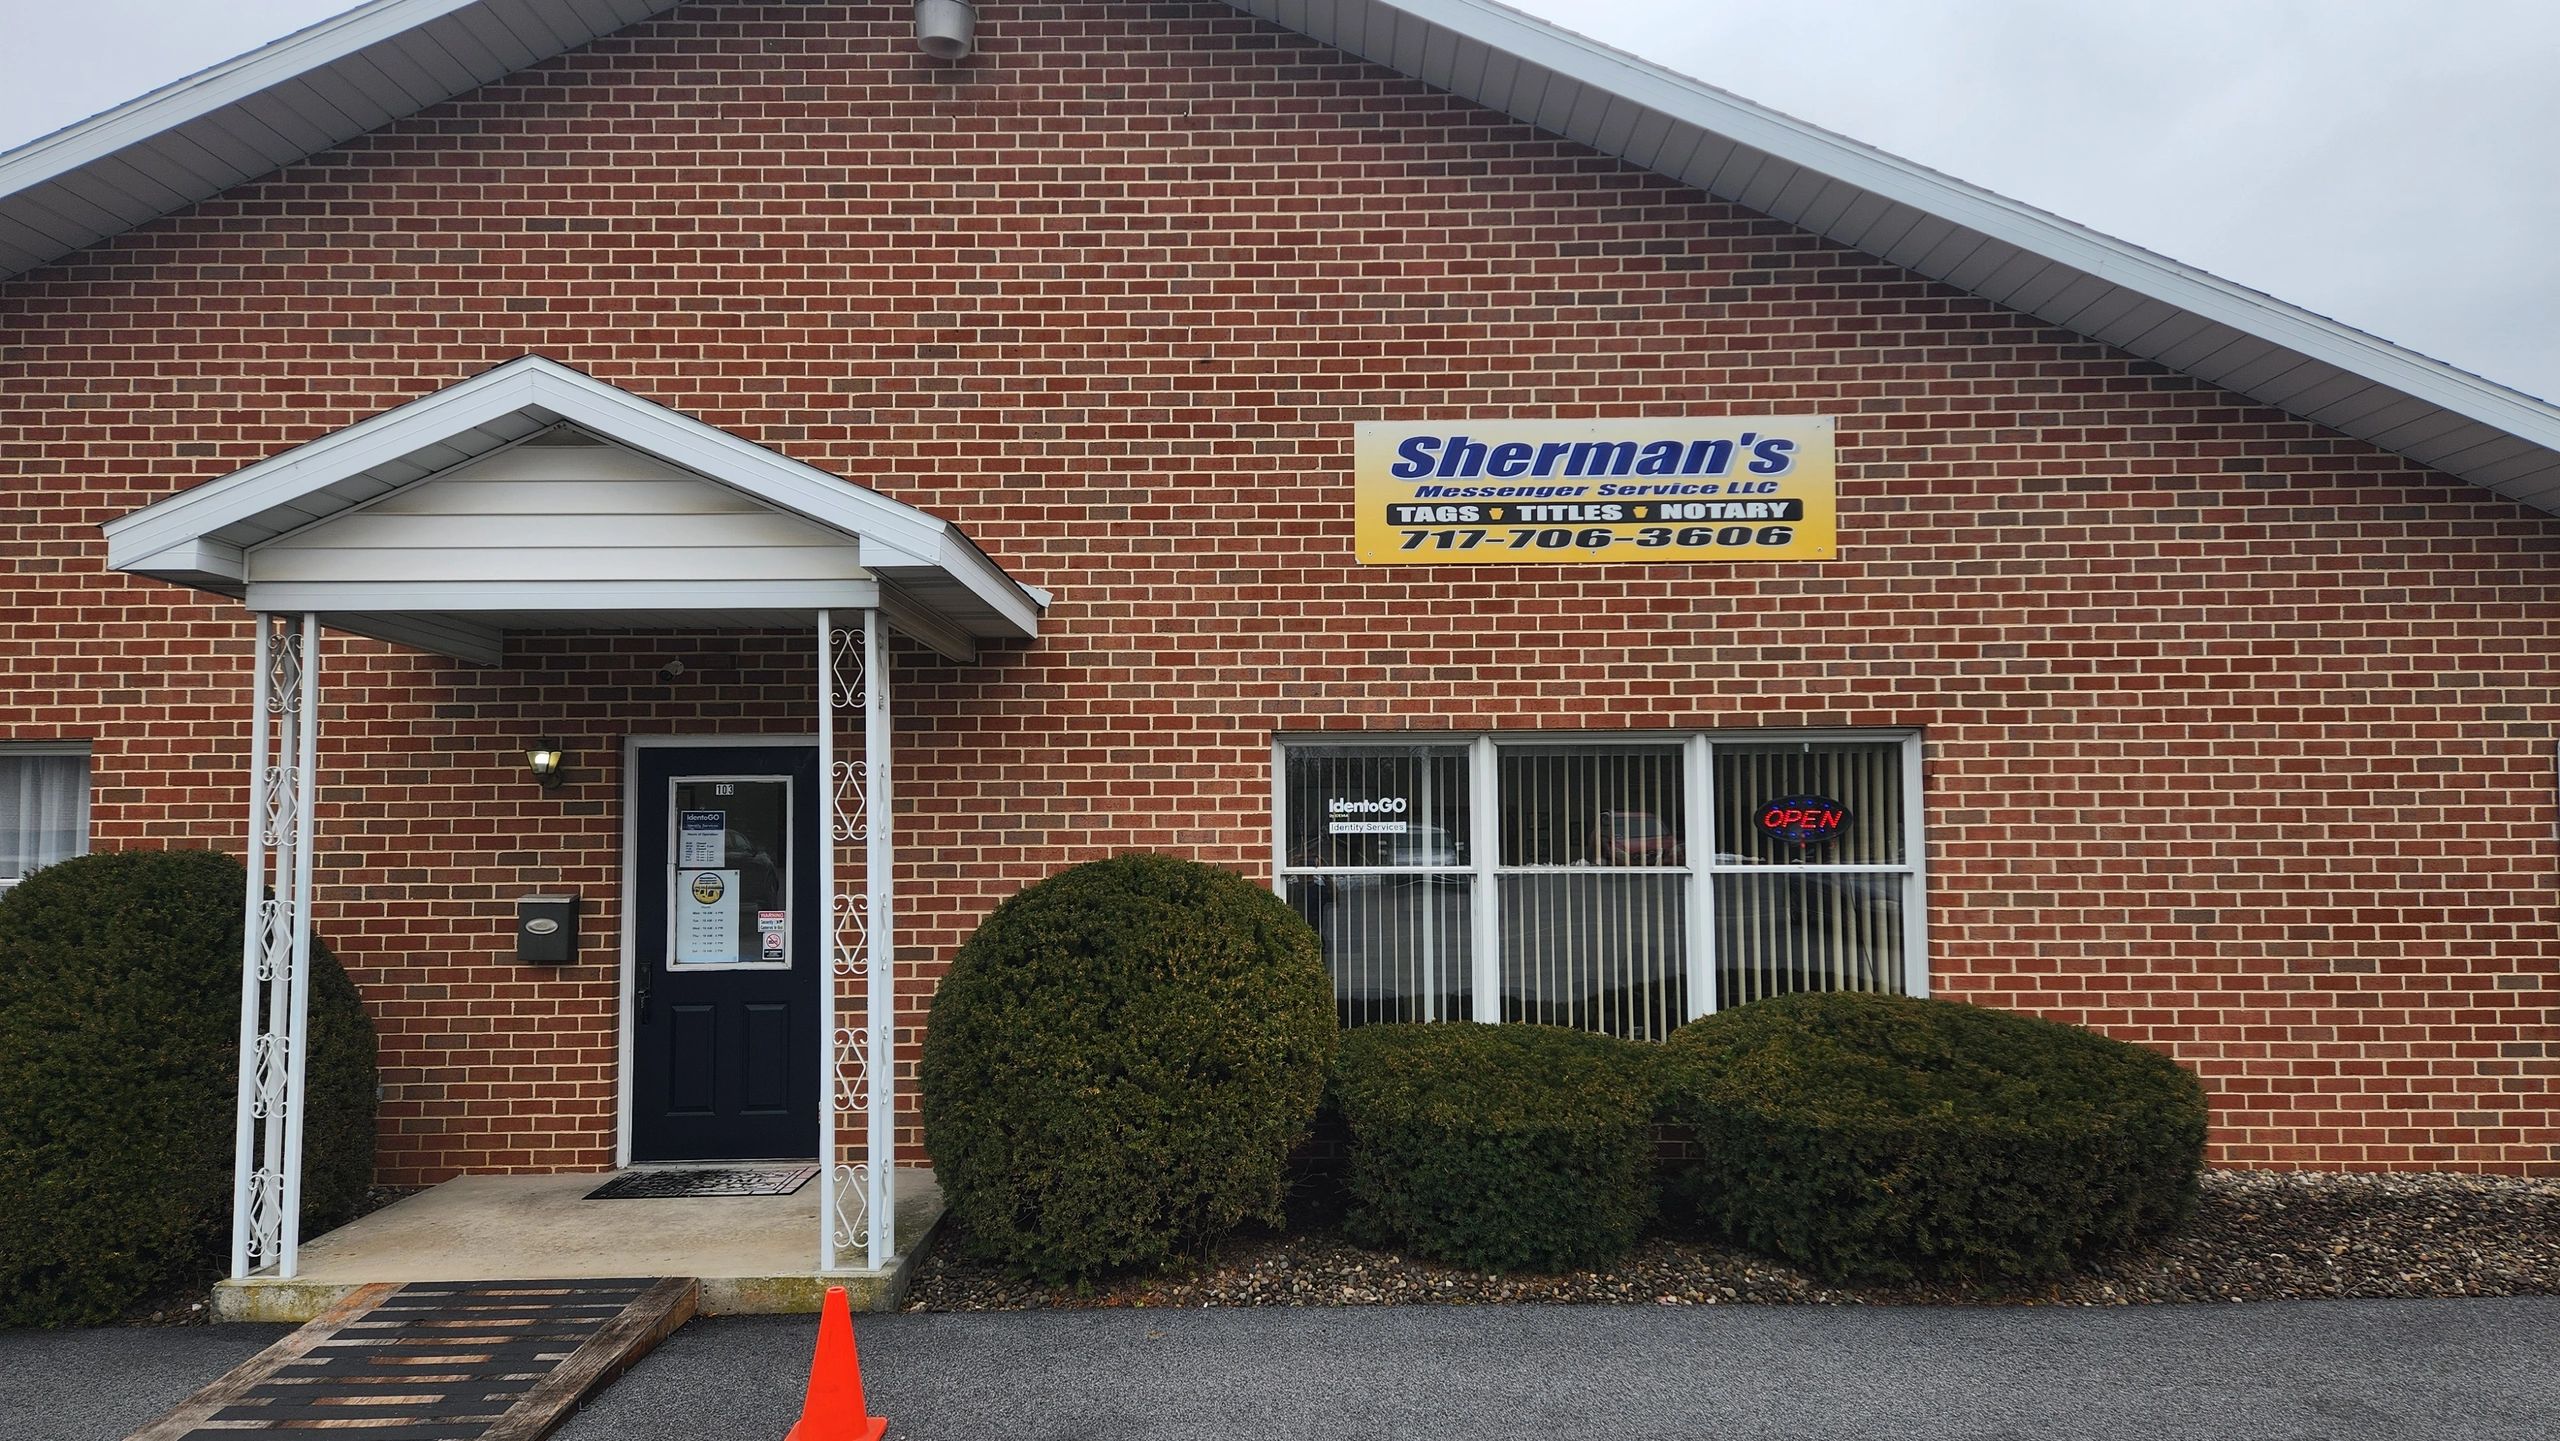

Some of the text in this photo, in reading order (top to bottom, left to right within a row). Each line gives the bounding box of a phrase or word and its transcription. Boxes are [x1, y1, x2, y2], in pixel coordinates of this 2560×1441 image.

[1391, 432, 1795, 478] Sherman's
[1414, 481, 1778, 498] Messenger Service LLC
[1396, 502, 1789, 522] TAGS TITLES NOTARY
[1400, 526, 1794, 549] 717-706-3606
[717, 784, 733, 795] 103
[1328, 797, 1407, 813] IdentoGO
[1331, 823, 1404, 832] Identity Services
[1763, 809, 1843, 829] OPEN
